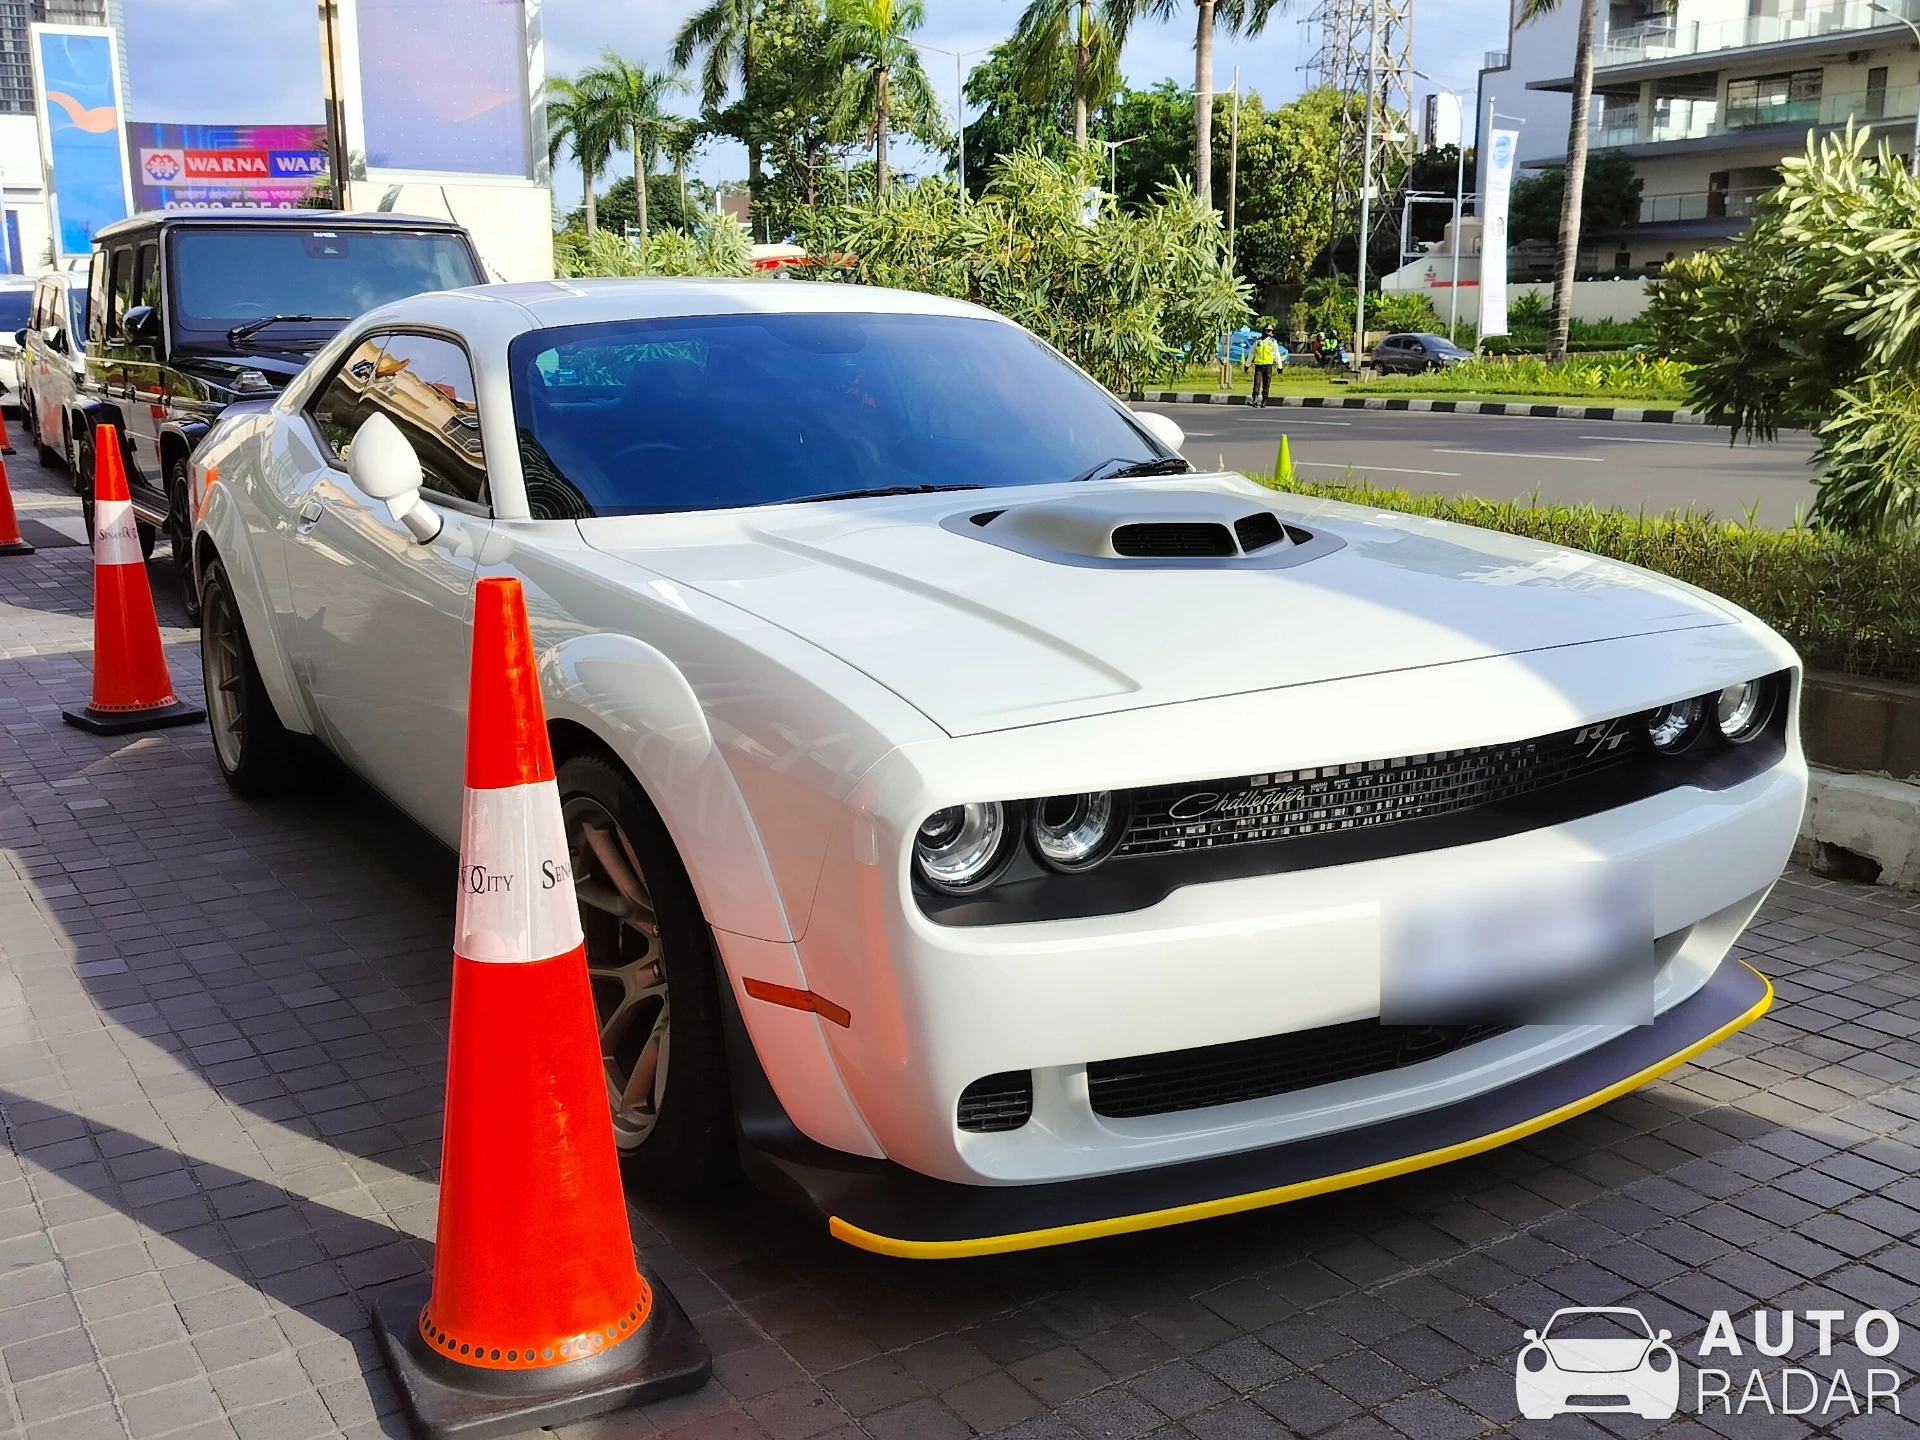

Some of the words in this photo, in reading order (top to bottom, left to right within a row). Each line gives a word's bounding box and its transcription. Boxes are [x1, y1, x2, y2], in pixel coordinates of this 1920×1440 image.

[186, 157, 267, 172] WARNA
[1573, 718, 1630, 758] R/T
[1168, 788, 1305, 819] Challenger
